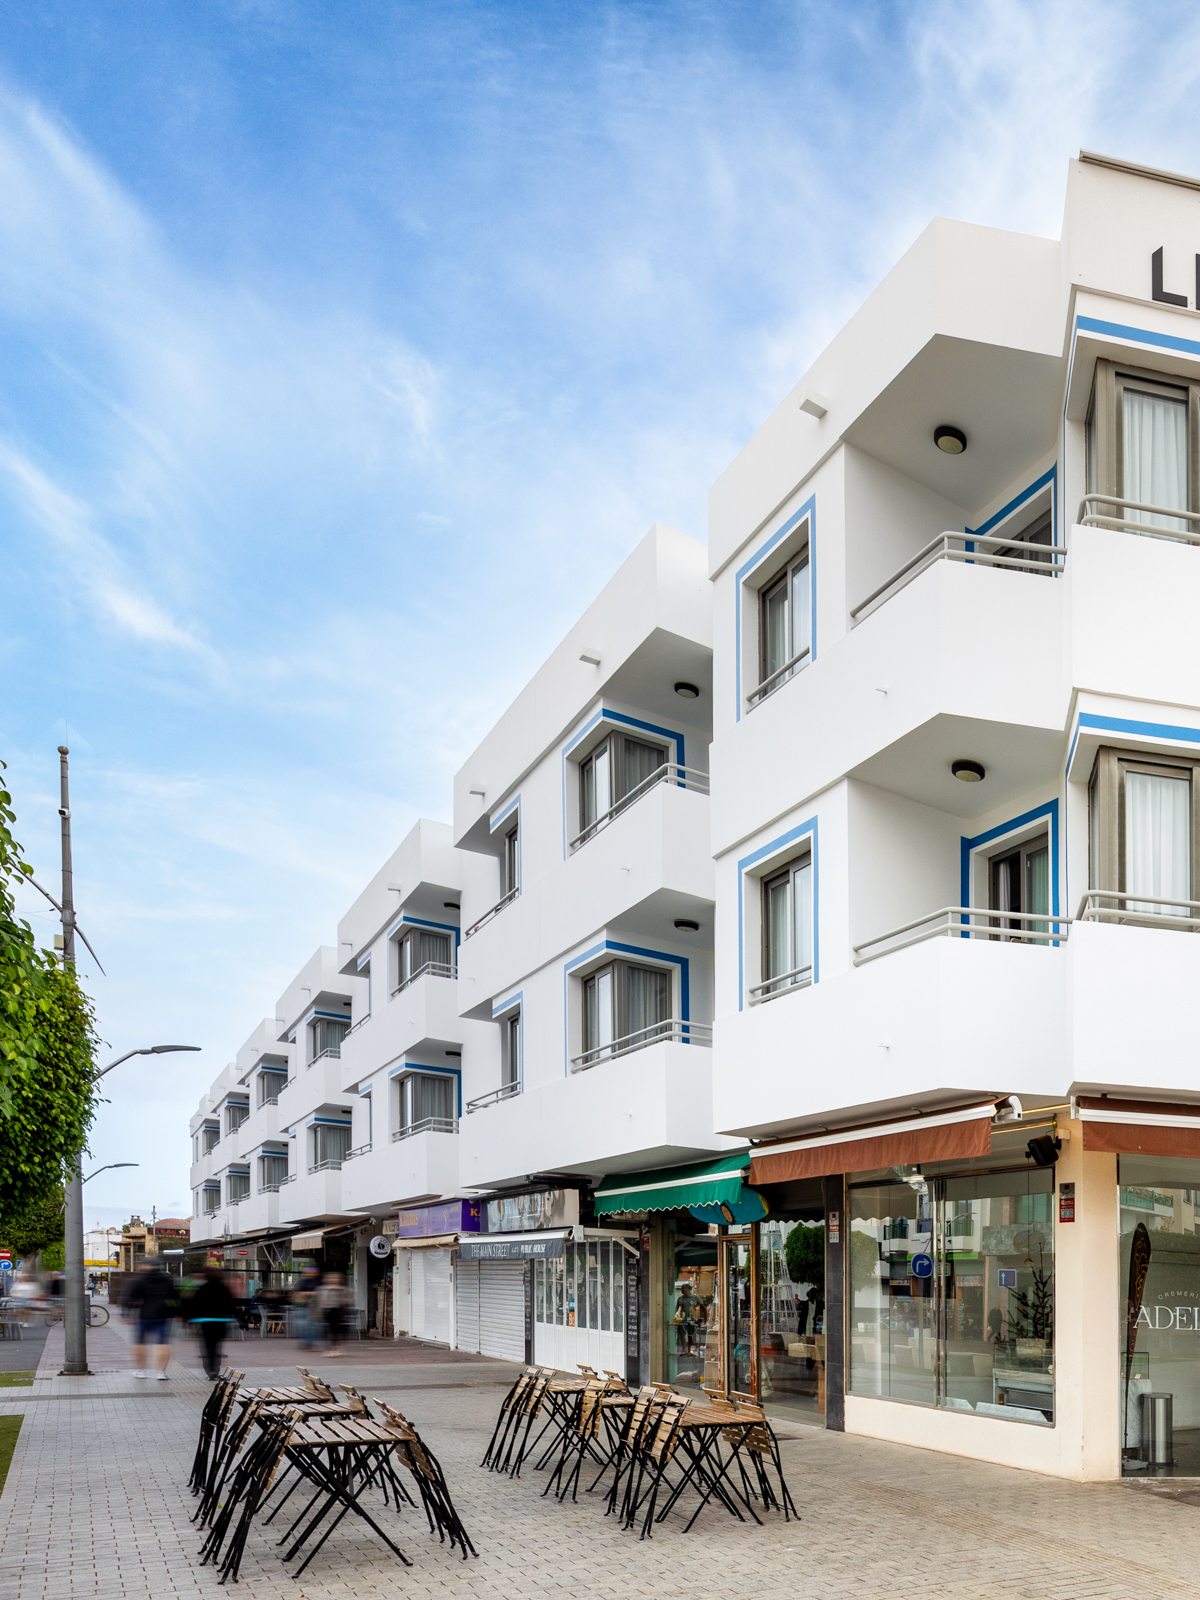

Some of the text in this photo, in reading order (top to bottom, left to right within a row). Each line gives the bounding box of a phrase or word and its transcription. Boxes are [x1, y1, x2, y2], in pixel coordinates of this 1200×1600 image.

[471, 1245, 480, 1257] THE
[480, 1244, 491, 1257] MAIN
[492, 1243, 510, 1257] STREET
[533, 1244, 546, 1253] HOUSE
